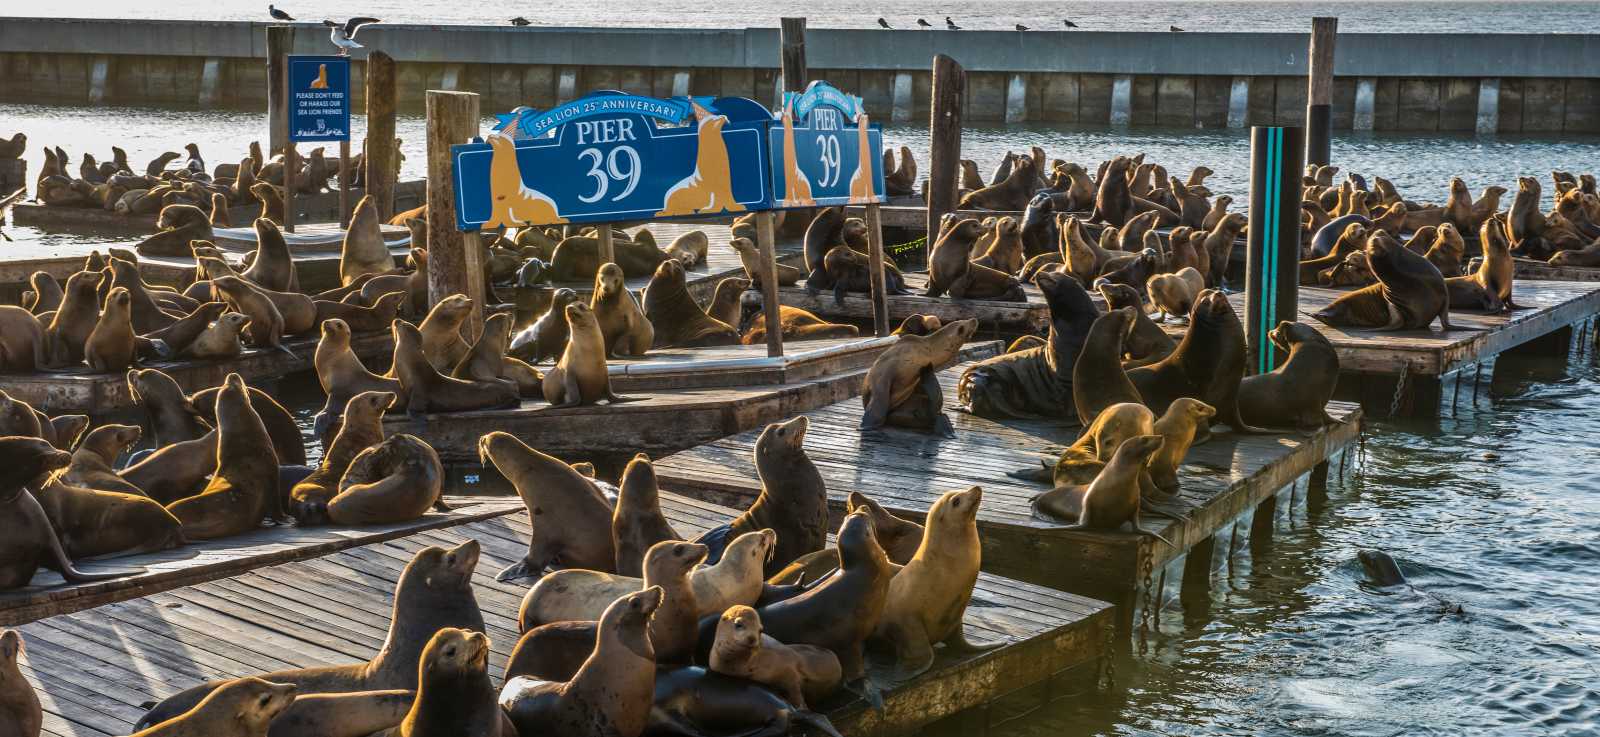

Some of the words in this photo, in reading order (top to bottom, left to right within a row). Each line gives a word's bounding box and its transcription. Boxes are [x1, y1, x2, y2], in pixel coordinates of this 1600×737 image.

[536, 116, 554, 129] SEA
[556, 106, 580, 120] LION
[602, 100, 676, 118] ANNIVERSARY
[814, 108, 838, 130] PIER
[576, 118, 636, 144] PIER
[578, 145, 642, 203] 39
[816, 134, 840, 188] 39
